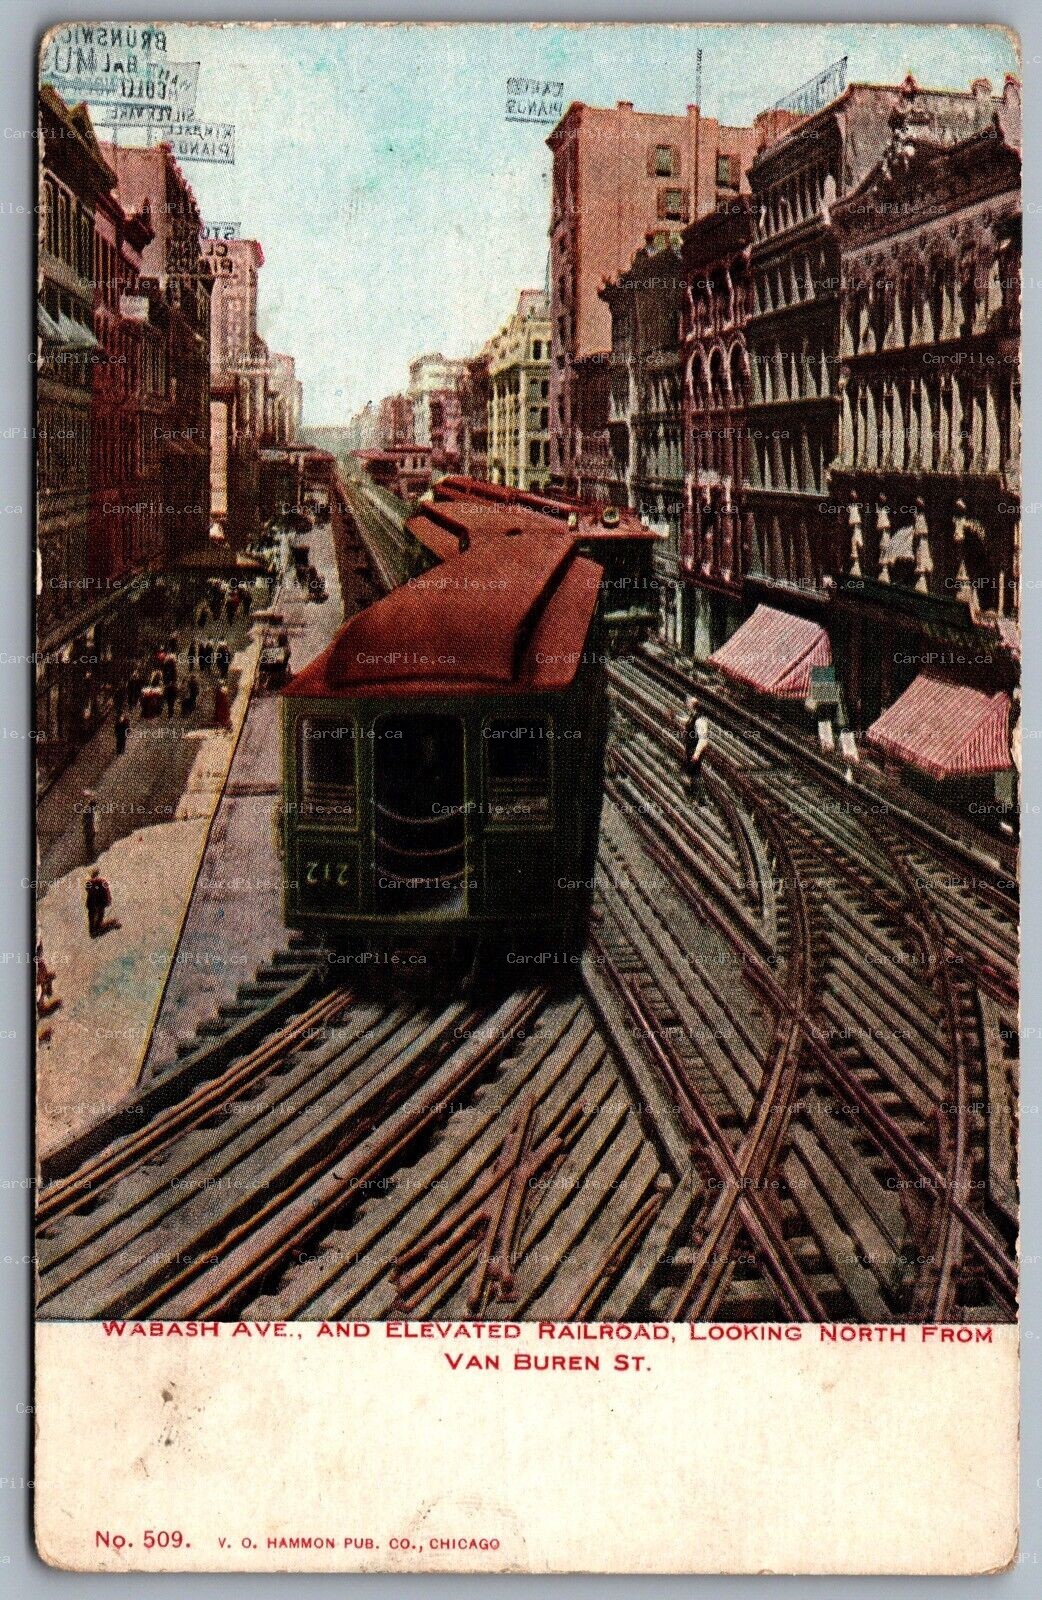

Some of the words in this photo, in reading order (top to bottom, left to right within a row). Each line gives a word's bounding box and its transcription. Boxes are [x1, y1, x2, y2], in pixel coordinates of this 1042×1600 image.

[143, 1530, 191, 1549] 509.
[218, 1537, 231, 1549] V.
[241, 1537, 257, 1549] O.
[266, 1537, 336, 1549] HAMMON
[344, 1537, 380, 1549] PUB.
[388, 1537, 424, 1552] CO.,
[430, 1537, 501, 1550] CHICAGO
